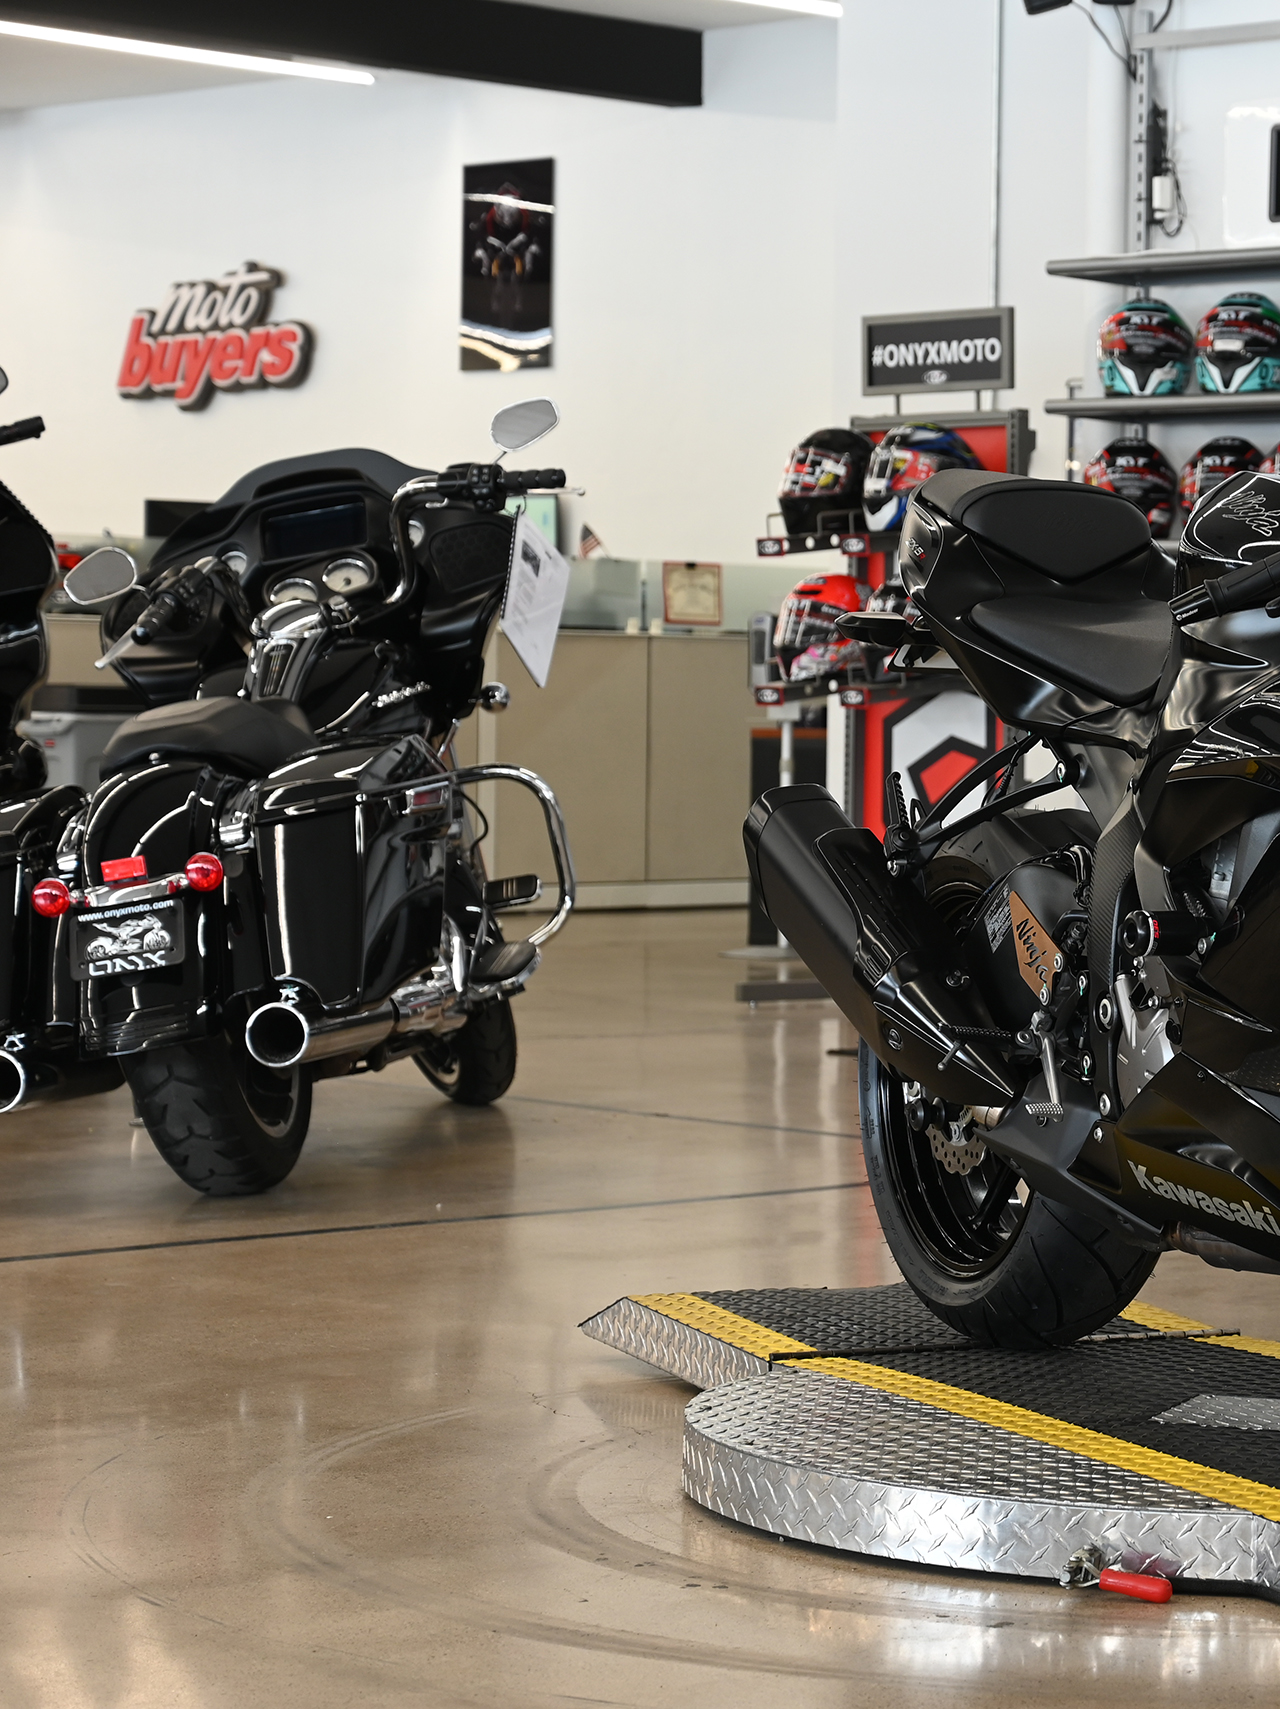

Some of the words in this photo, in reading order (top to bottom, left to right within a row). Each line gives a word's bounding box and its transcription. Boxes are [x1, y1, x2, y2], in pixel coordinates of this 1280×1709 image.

[117, 315, 300, 402] buyers
[872, 337, 1002, 368] #ONYXMOTO
[78, 900, 174, 922] www.onyxmoto.com
[1016, 918, 1048, 985] Ninja
